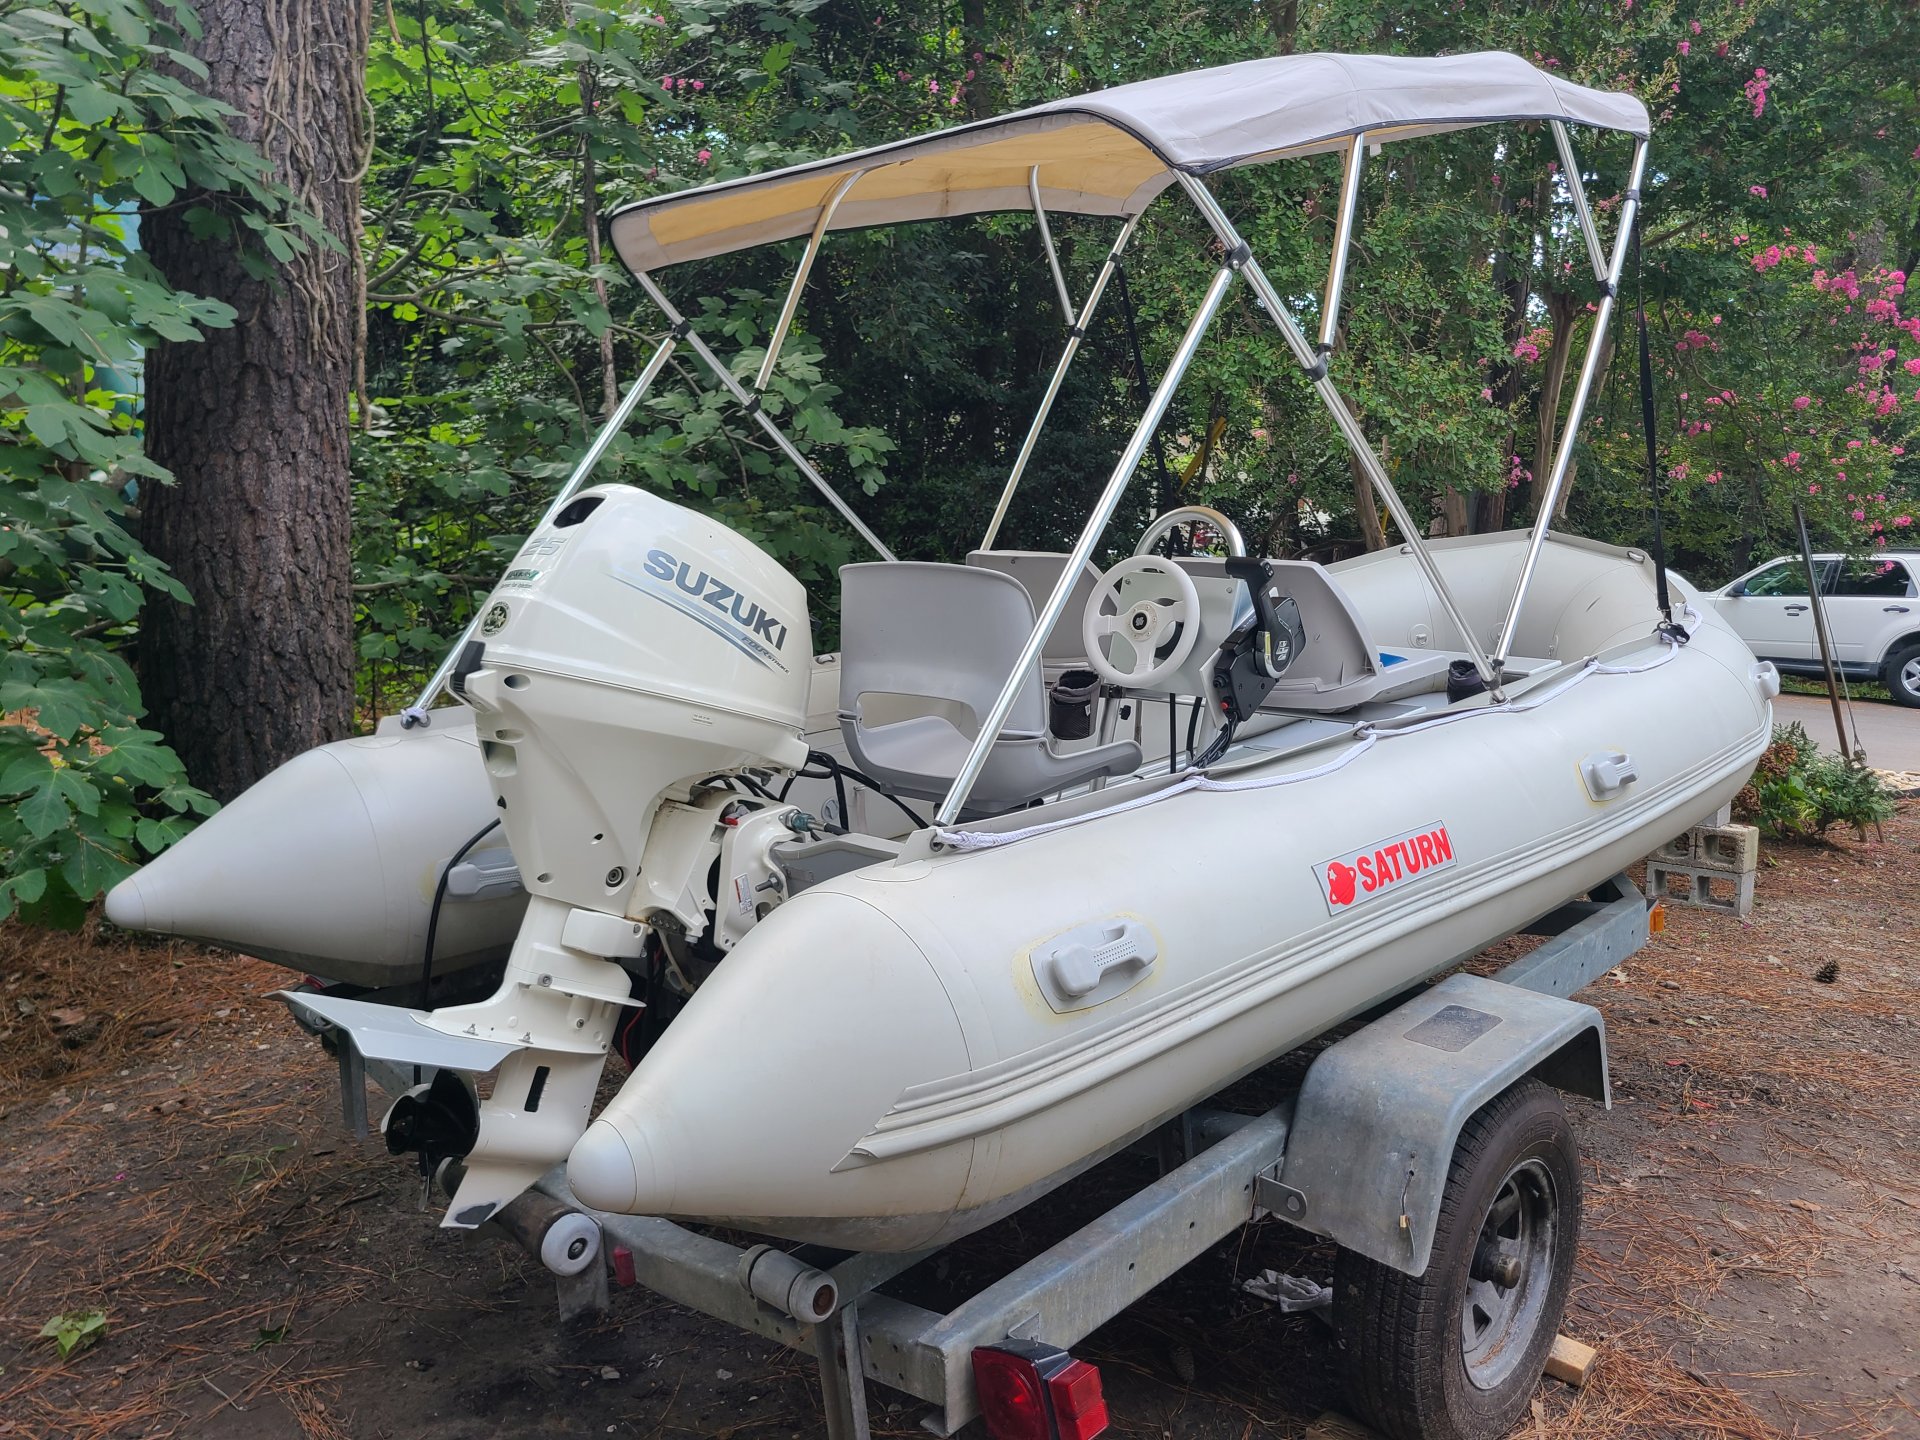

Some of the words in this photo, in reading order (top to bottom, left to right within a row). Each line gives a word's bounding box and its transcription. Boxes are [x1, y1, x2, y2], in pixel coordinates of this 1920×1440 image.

[520, 537, 567, 557] 25
[643, 549, 788, 651] SUZUKI
[1357, 828, 1452, 892] SATURN
